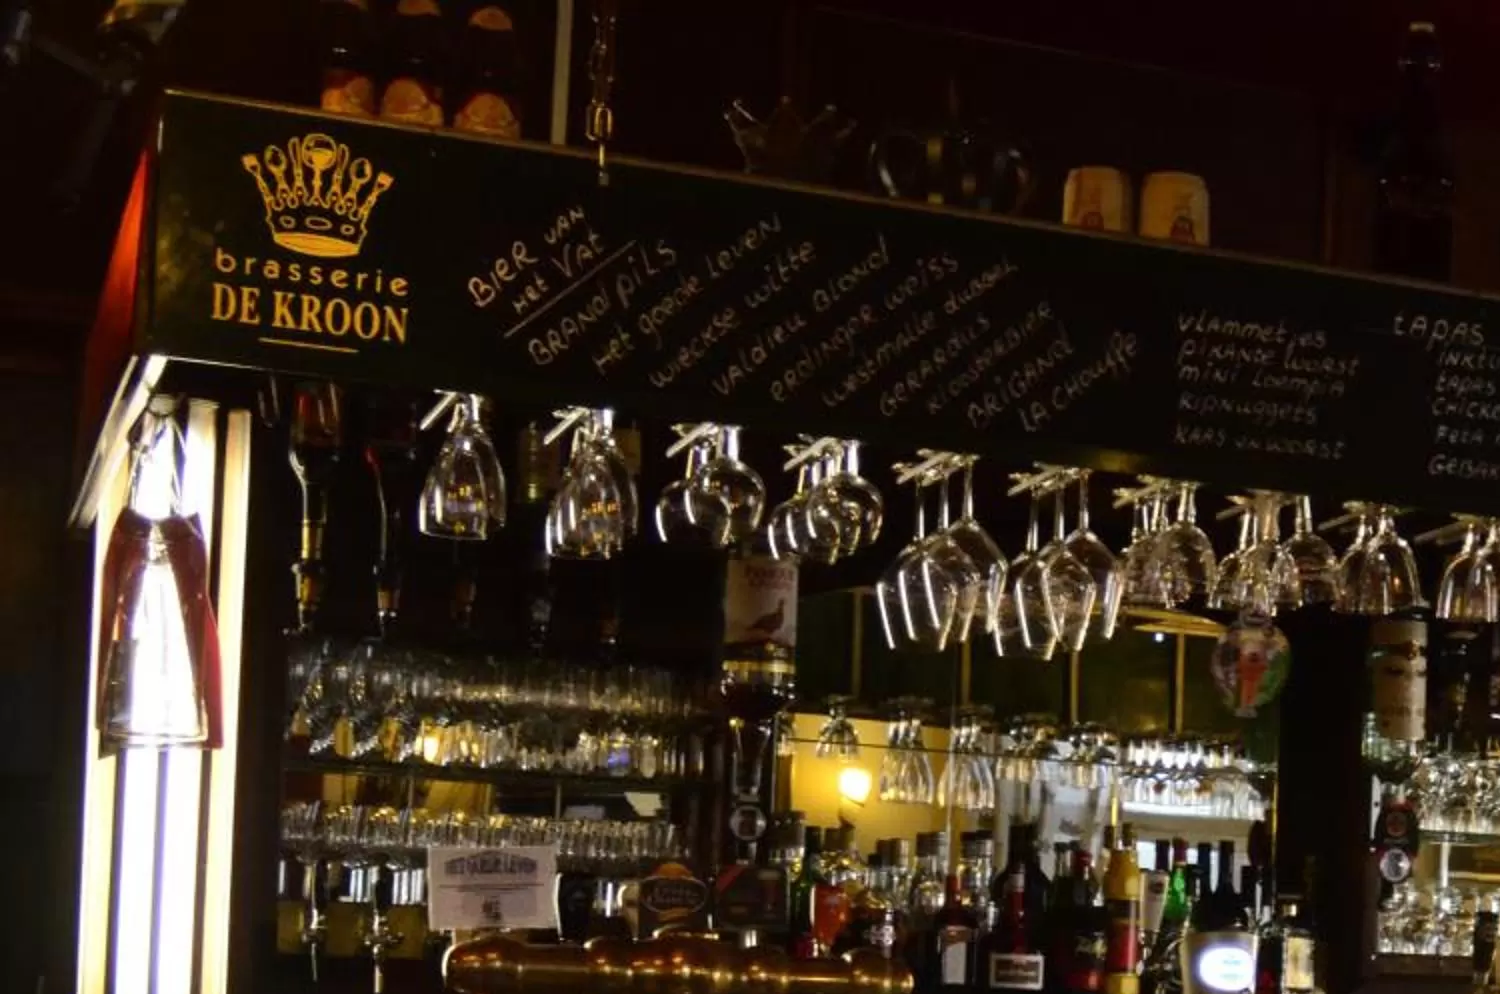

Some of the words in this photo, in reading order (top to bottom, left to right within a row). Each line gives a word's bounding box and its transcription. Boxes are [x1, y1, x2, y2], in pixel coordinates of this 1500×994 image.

[215, 247, 409, 297] brasserie
[211, 282, 262, 326] DE
[271, 290, 409, 345] KROON
